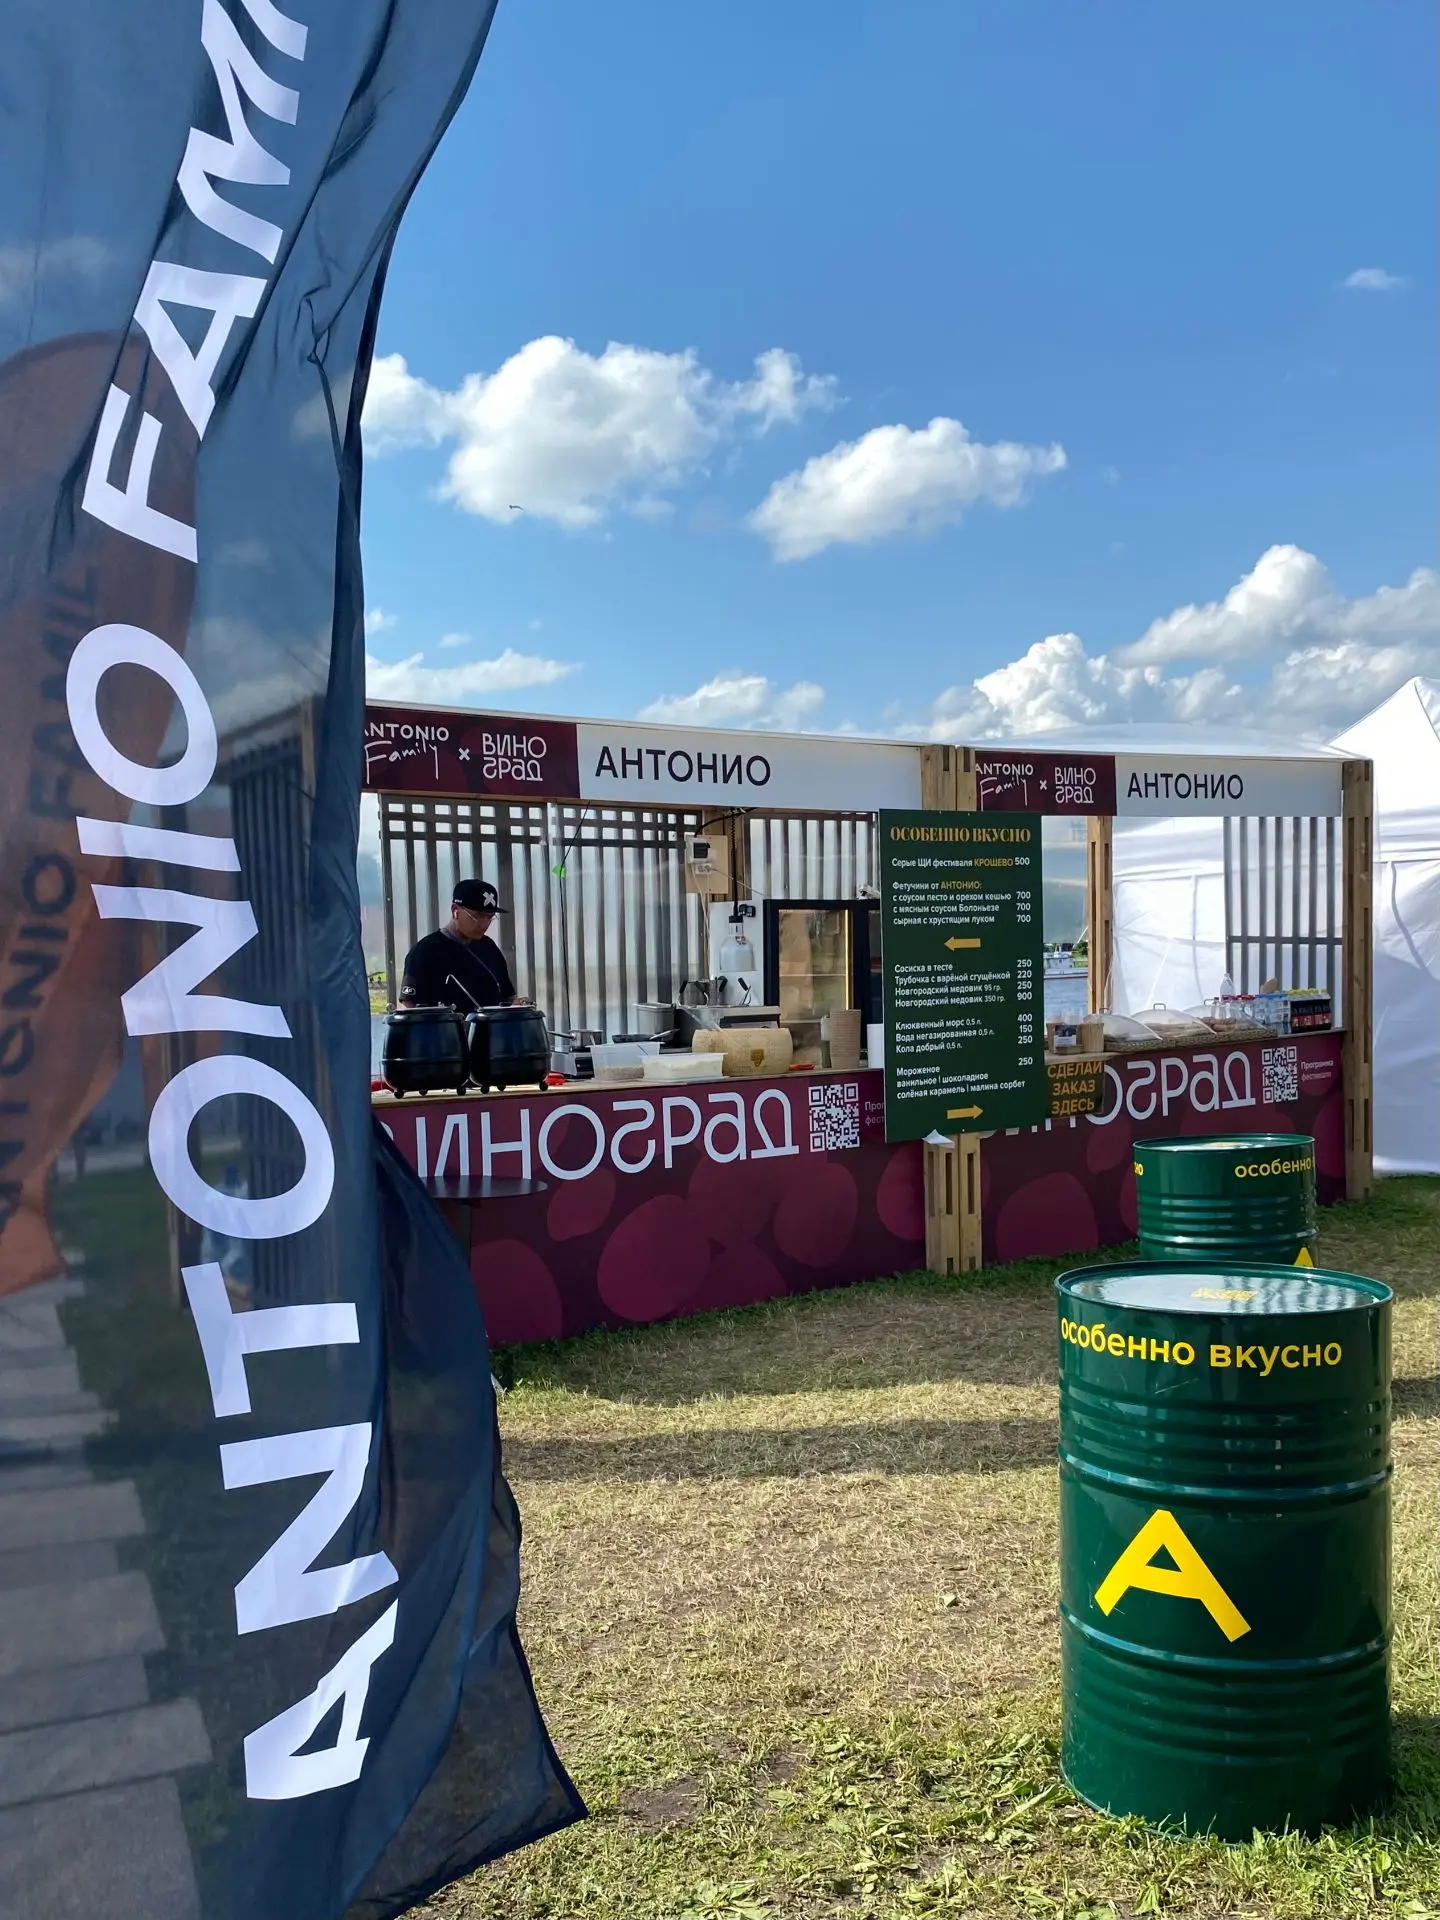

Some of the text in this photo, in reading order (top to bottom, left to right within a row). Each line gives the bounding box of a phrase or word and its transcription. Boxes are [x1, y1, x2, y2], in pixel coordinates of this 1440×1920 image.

[364, 736, 438, 784] Family
[595, 745, 771, 787] АНТОНИО
[1128, 772, 1244, 800] АНТОНИО
[890, 826, 1031, 842] ОСОБЕННО ВКУСНО
[892, 857, 1030, 868] Серые ЩИ фестиваля КРОШЕВО 500
[892, 882, 929, 891] Фетучини
[941, 881, 982, 889] АНТОНИО:
[898, 894, 925, 903] соусом
[956, 894, 984, 902] орехом
[1016, 891, 1031, 899] 700
[931, 905, 957, 914] соусом
[959, 904, 999, 912] Болоньезе
[1016, 903, 1031, 911] 700
[893, 917, 922, 926] сырная
[929, 917, 969, 925] хрустящим
[894, 964, 925, 972] Сосиска
[1017, 959, 1032, 968] 250
[895, 976, 929, 986] Трубочка
[937, 974, 968, 984] варёной
[970, 971, 1010, 981] сгущёнкой
[1017, 970, 1032, 979] 220
[895, 986, 948, 996] Новгородский
[950, 985, 982, 994] медовик
[1017, 981, 1032, 990] 250
[895, 997, 948, 1007] Новгородский
[950, 996, 982, 1005] медовик
[1017, 992, 1032, 1001] 900
[896, 1020, 944, 1030] Клюквенный
[946, 1020, 964, 1029] морс
[1018, 1014, 1032, 1022] 400
[896, 1034, 915, 1042] Вода
[916, 1029, 977, 1041] негазированная
[1019, 1024, 1032, 1033] 150
[896, 1045, 914, 1053] Кола
[916, 1043, 945, 1053] добрый
[1018, 1036, 1032, 1044] 250
[897, 1057, 1032, 1077] Мороженое 250
[1047, 1060, 1103, 1079] СДЕЛАЙ
[897, 1077, 937, 1087] ванильное
[942, 1073, 988, 1084] шоколадное
[1052, 1079, 1096, 1096] ЗАКАЗ
[897, 1088, 928, 1099] солёная
[929, 1085, 965, 1097] карамель
[970, 1084, 998, 1093] малина
[1000, 1080, 1025, 1089] сорбет
[1051, 1097, 1095, 1116] ЗДЕСЬ
[1234, 1158, 1312, 1178] особенно
[66, 623, 398, 1800] ANTONIO
[1061, 1316, 1343, 1377] особенно вкусно
